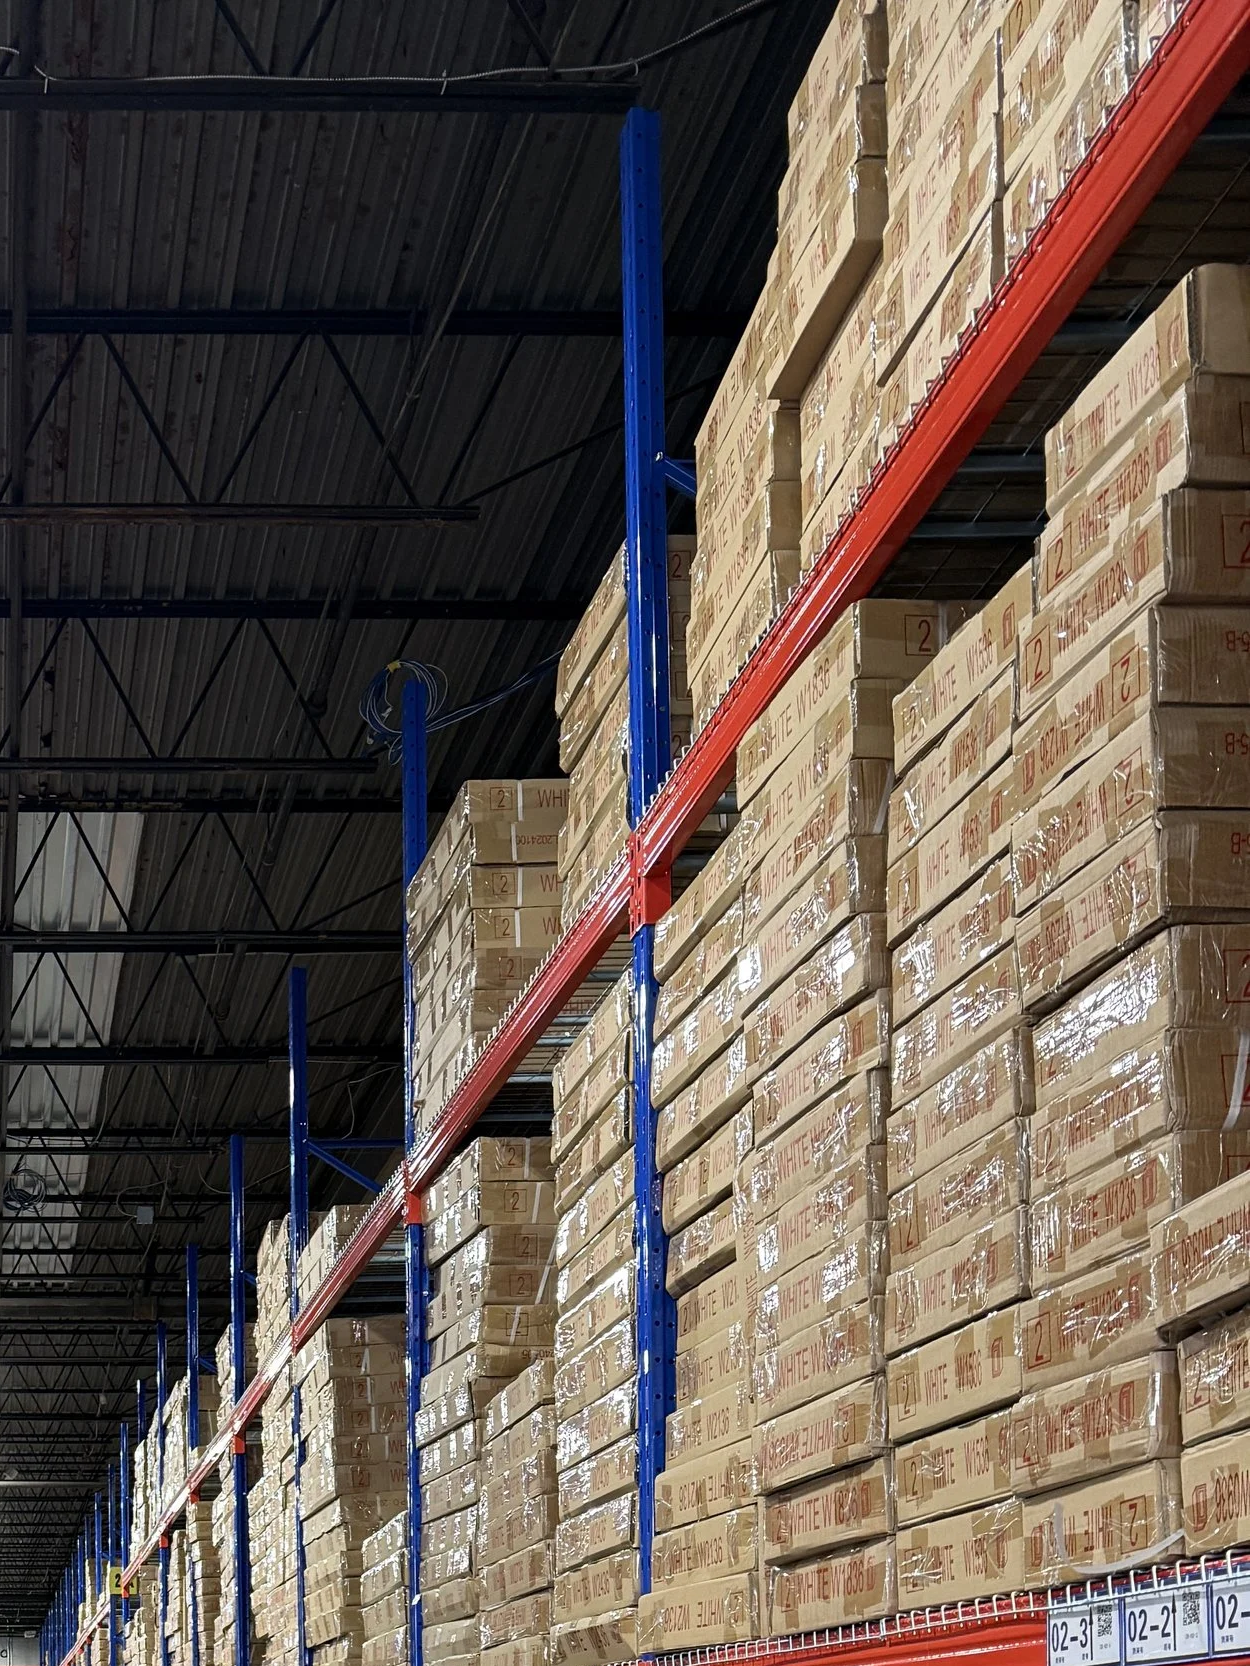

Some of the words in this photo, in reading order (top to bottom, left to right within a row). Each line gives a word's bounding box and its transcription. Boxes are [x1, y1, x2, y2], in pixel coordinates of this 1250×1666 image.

[736, 403, 763, 464] W1836
[1087, 383, 1122, 449] WHITE
[1054, 537, 1064, 582] 2
[1078, 487, 1110, 552] WHITE
[1116, 446, 1151, 515] W1236
[917, 619, 932, 653] 2
[1031, 638, 1043, 681] 2
[1056, 593, 1089, 656] WHITE
[930, 663, 959, 721] WHITE
[1120, 656, 1131, 703] 2
[760, 699, 793, 762] WHITE
[795, 658, 831, 713] W1836
[496, 789, 506, 808] 2
[537, 787, 571, 809] WHI
[923, 756, 947, 810] WHITE
[760, 787, 794, 835] WHITE
[1076, 782, 1109, 843] WHITE
[761, 852, 791, 901] WHITE
[925, 839, 951, 893] WHITE
[764, 922, 792, 971] WHITE
[777, 1129, 811, 1183] WHITE
[780, 1205, 812, 1251] WHITE
[923, 1363, 949, 1406] WHITE
[800, 1417, 834, 1459] WHITE
[788, 1507, 820, 1539] WHITE
[1083, 1506, 1114, 1552] WHITE
[1128, 1502, 1139, 1547] 2
[799, 1571, 829, 1608] WHITE
[1215, 1593, 1250, 1631] 02-
[697, 1607, 725, 1629] WHITE
[1051, 1617, 1088, 1653] 02-3
[1127, 1605, 1171, 1643] 02-2
